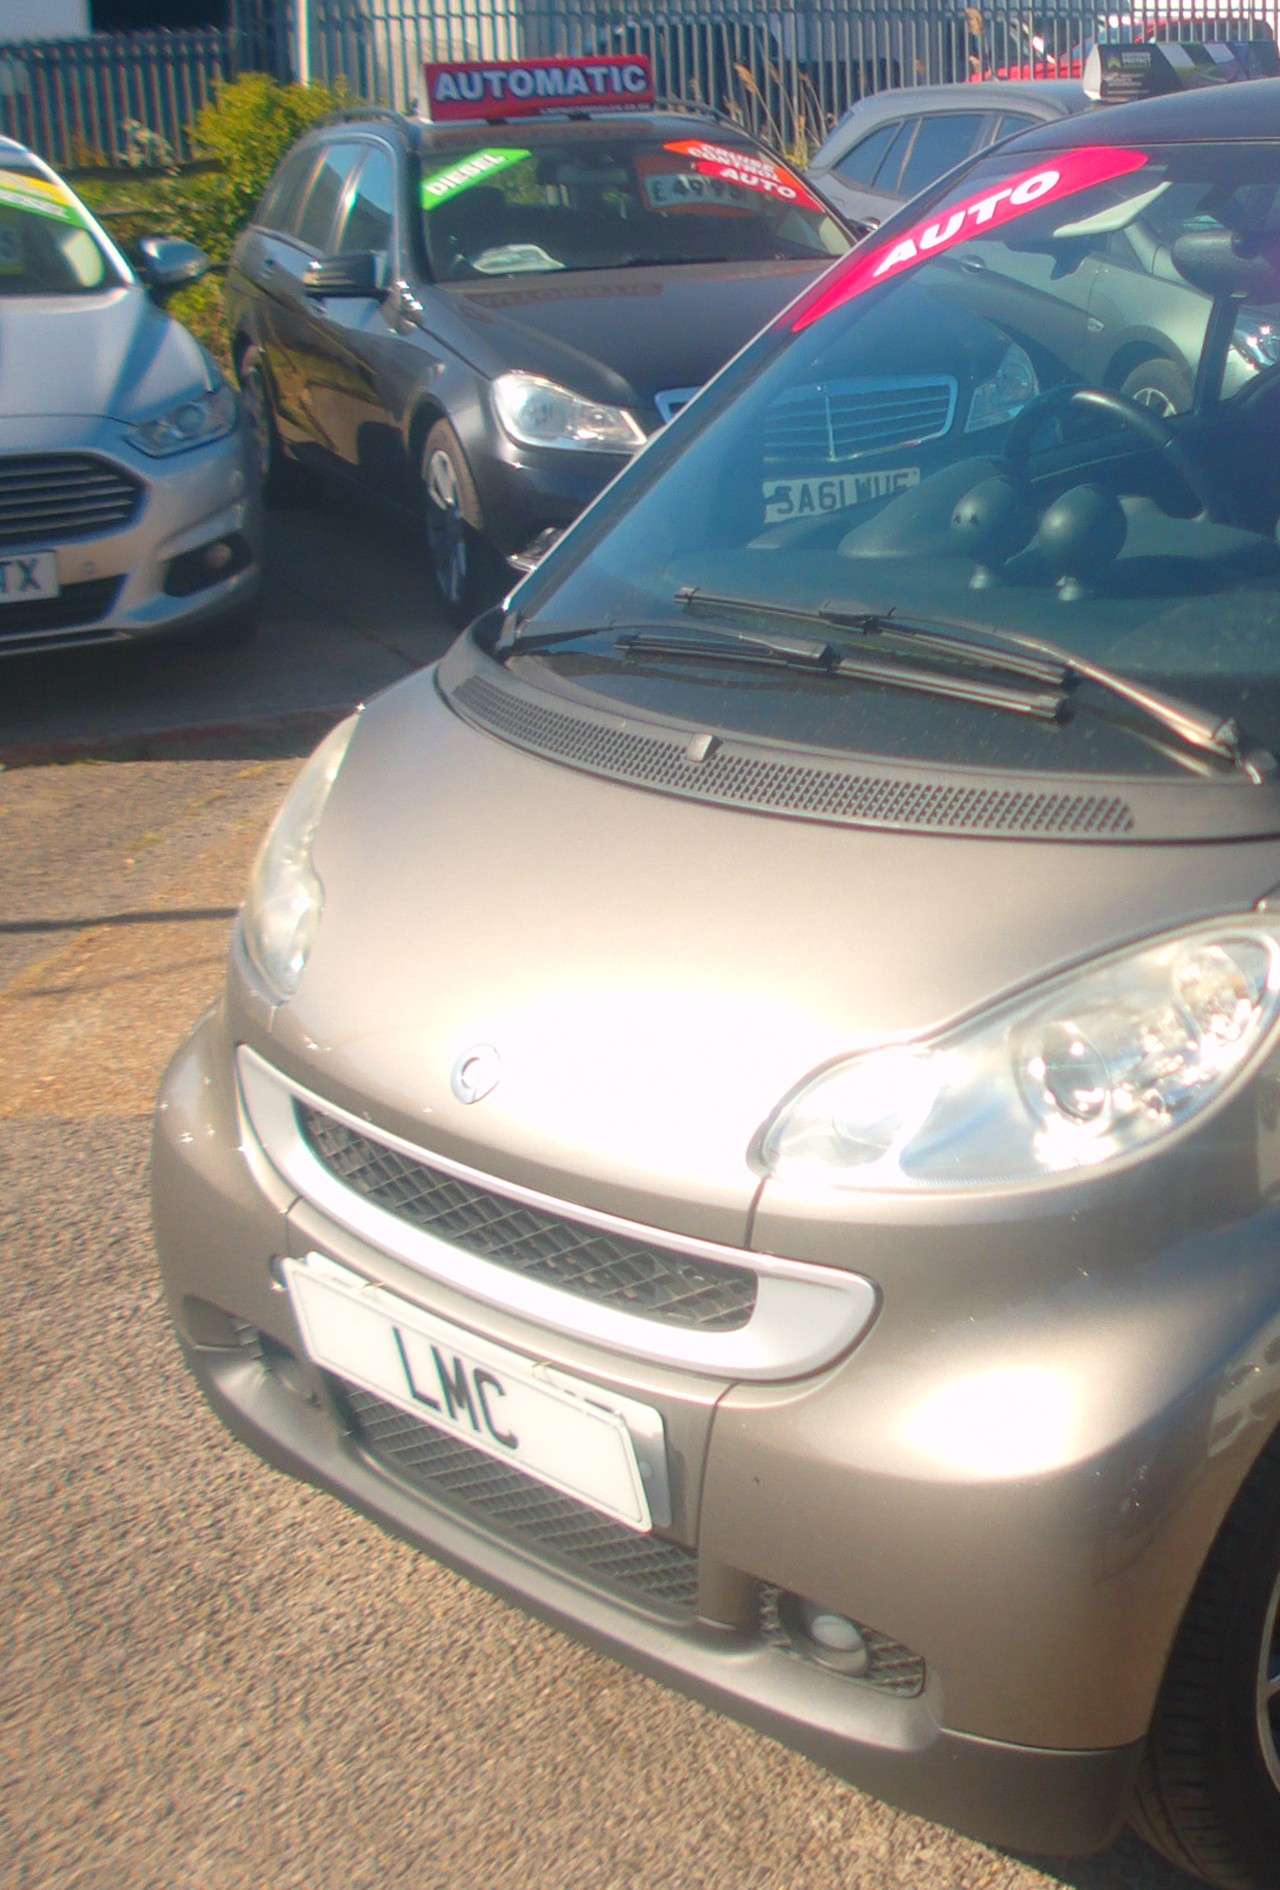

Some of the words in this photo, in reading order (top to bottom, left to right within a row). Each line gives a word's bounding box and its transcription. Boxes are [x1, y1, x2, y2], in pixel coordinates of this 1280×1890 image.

[435, 64, 648, 101] AUTOMATIC
[423, 153, 507, 197] DIESEL
[719, 167, 797, 199] AUTO
[872, 169, 1061, 278] AUTO
[0, 559, 42, 592] TX
[391, 1325, 520, 1451] LMC
